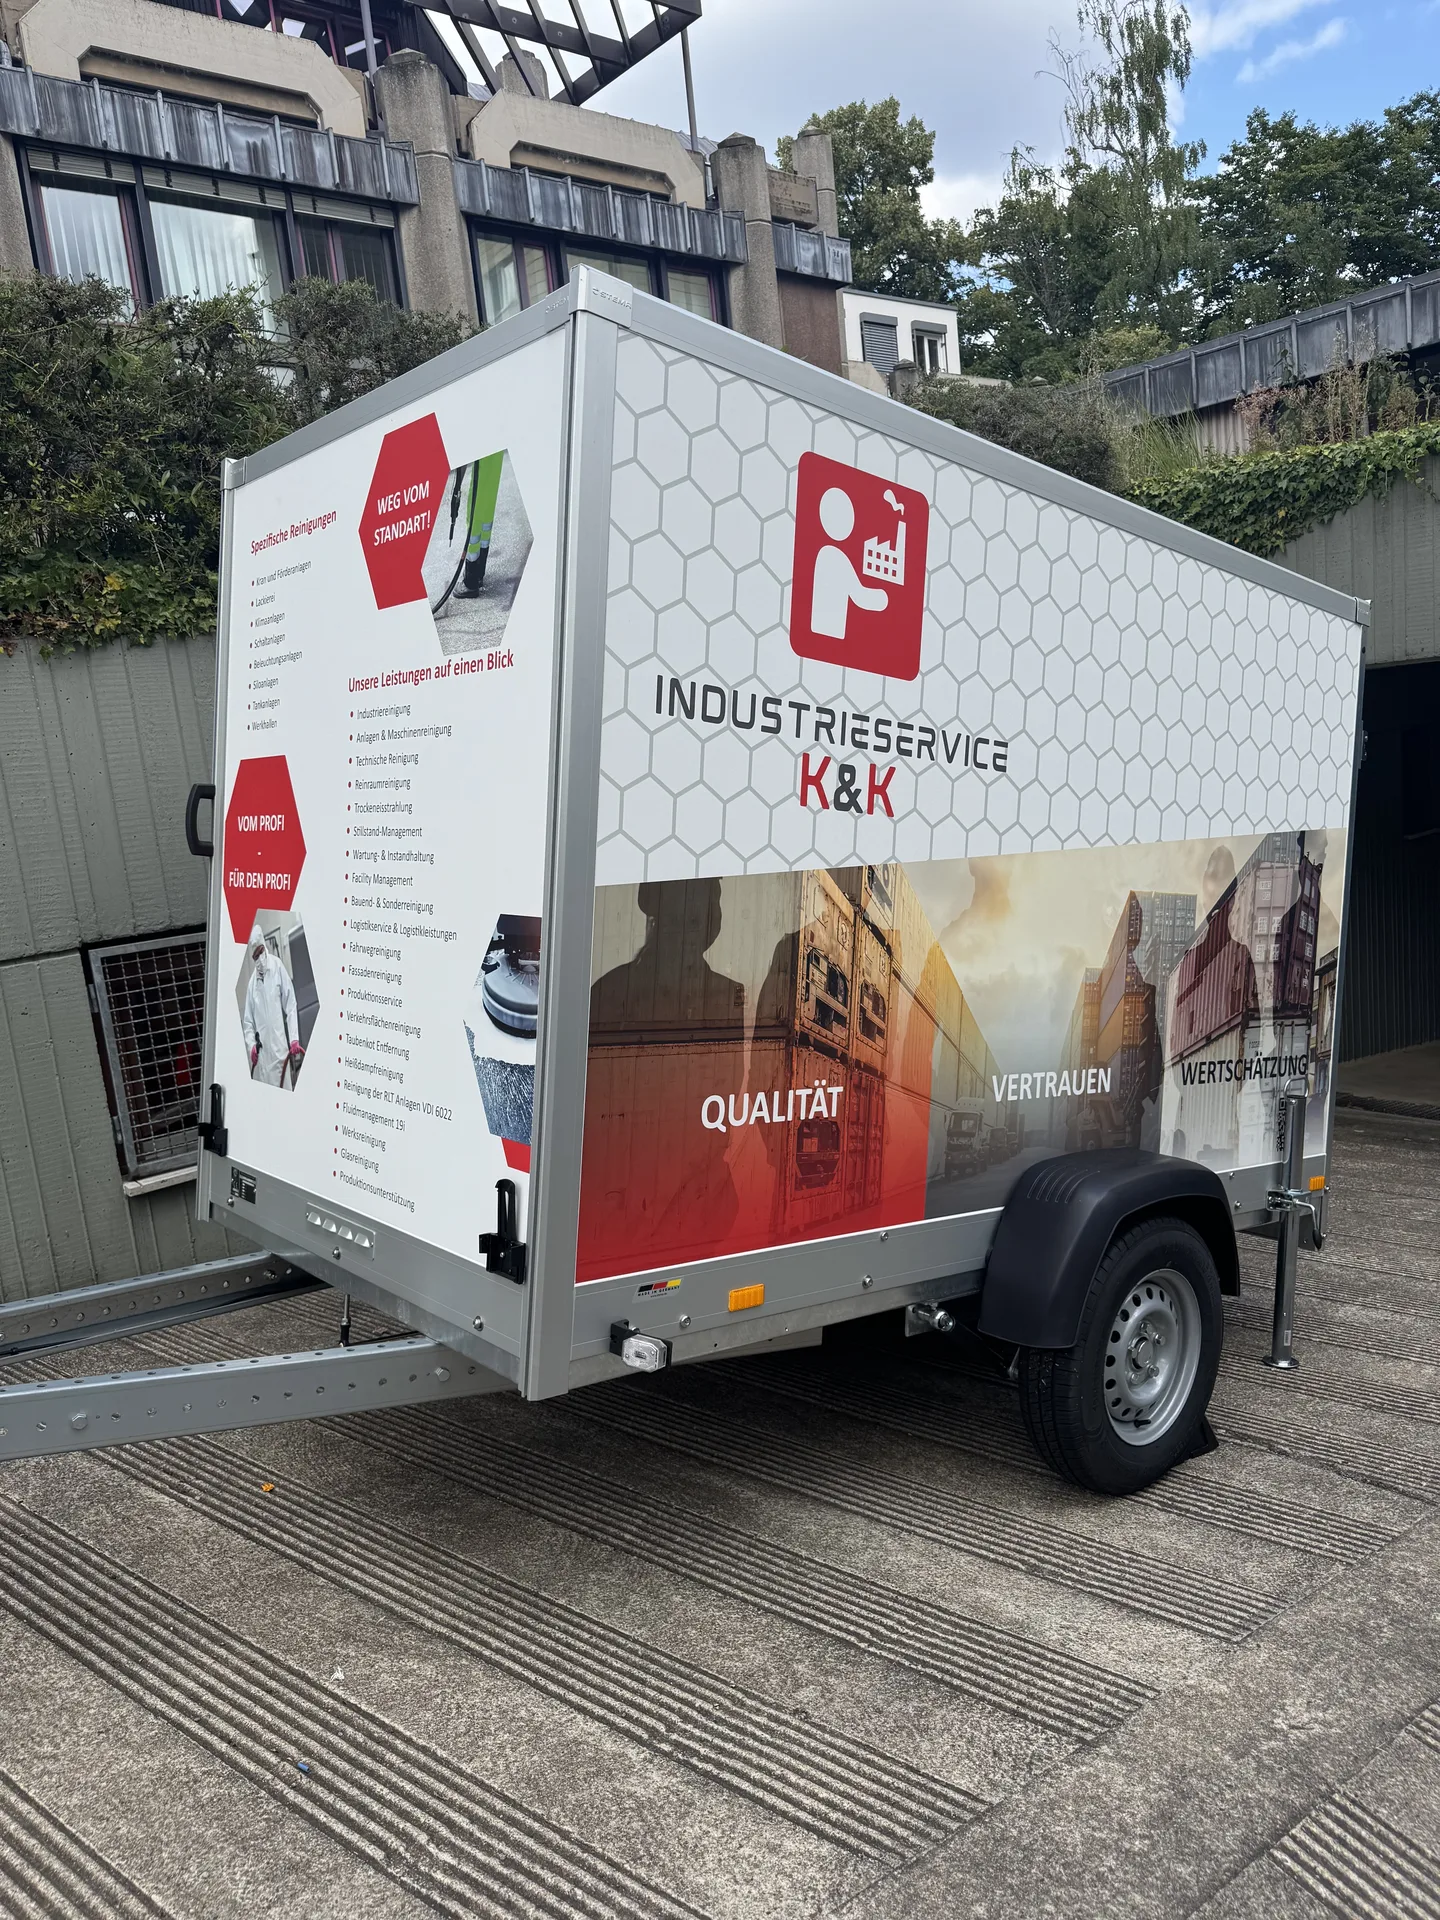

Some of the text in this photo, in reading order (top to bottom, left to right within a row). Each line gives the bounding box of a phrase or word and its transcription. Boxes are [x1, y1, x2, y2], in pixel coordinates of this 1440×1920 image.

[377, 480, 430, 515] WEG VOM
[251, 510, 337, 555] Spezifische Reinigungen
[374, 510, 431, 546] STANDART!
[256, 560, 312, 586] Kran und Förderanlagen
[255, 593, 276, 608] Lackierei
[255, 611, 285, 629] Klimaanlagen
[254, 632, 286, 650] Schaltanlagen
[253, 650, 303, 670] Beleuchtungsanlagen
[349, 649, 514, 693] Unsere Leistungen auf einen Blick
[253, 676, 279, 691] Siloanlagen
[252, 697, 281, 713] Tankanlagen
[357, 703, 411, 720] Industriereinigung
[252, 719, 277, 732] Werkhallen
[356, 724, 452, 745] Anlagen & Maschinenreinigung
[655, 674, 1009, 773] INDUSTRIESERVICE
[356, 752, 419, 767] Technische Reinigung
[355, 777, 411, 791] Reinraumreinigung
[799, 752, 896, 818] K&K
[354, 801, 413, 815] Trockeneisstrahlung
[237, 814, 285, 832] VOM PROFI
[353, 825, 423, 840] Stillstand-Management
[353, 849, 435, 865] Wartung- & Instandhaltung
[229, 868, 291, 891] FÜR DEN PROFI
[352, 873, 413, 888] Facility Management
[351, 895, 434, 915] Bauend- & Sonderreinigung
[350, 919, 458, 942] Logistikservice & Logistikleistungen
[349, 942, 402, 961] Fahrwegreinigung
[348, 965, 403, 985] Fassadenreinigung
[347, 988, 403, 1008] Produktionsservice
[346, 1011, 422, 1039] Verkehrsflächenreinigung
[345, 1033, 410, 1061] Taubenkot Entfernung
[344, 1056, 404, 1083] Heißdampfreinigung
[1181, 1052, 1308, 1086] WERTSCHÄTZUNG
[992, 1067, 1111, 1103] VERTRAUEN
[343, 1079, 453, 1121] Reinigung der RLT Anlagen VDI 6022
[700, 1078, 845, 1134] QUALITÄT
[342, 1102, 406, 1132] Fluidmanagement 19i
[341, 1124, 387, 1152] Werksreinigung
[340, 1147, 379, 1173] Glasreinigung
[339, 1170, 415, 1213] Produktionsunterstützung
